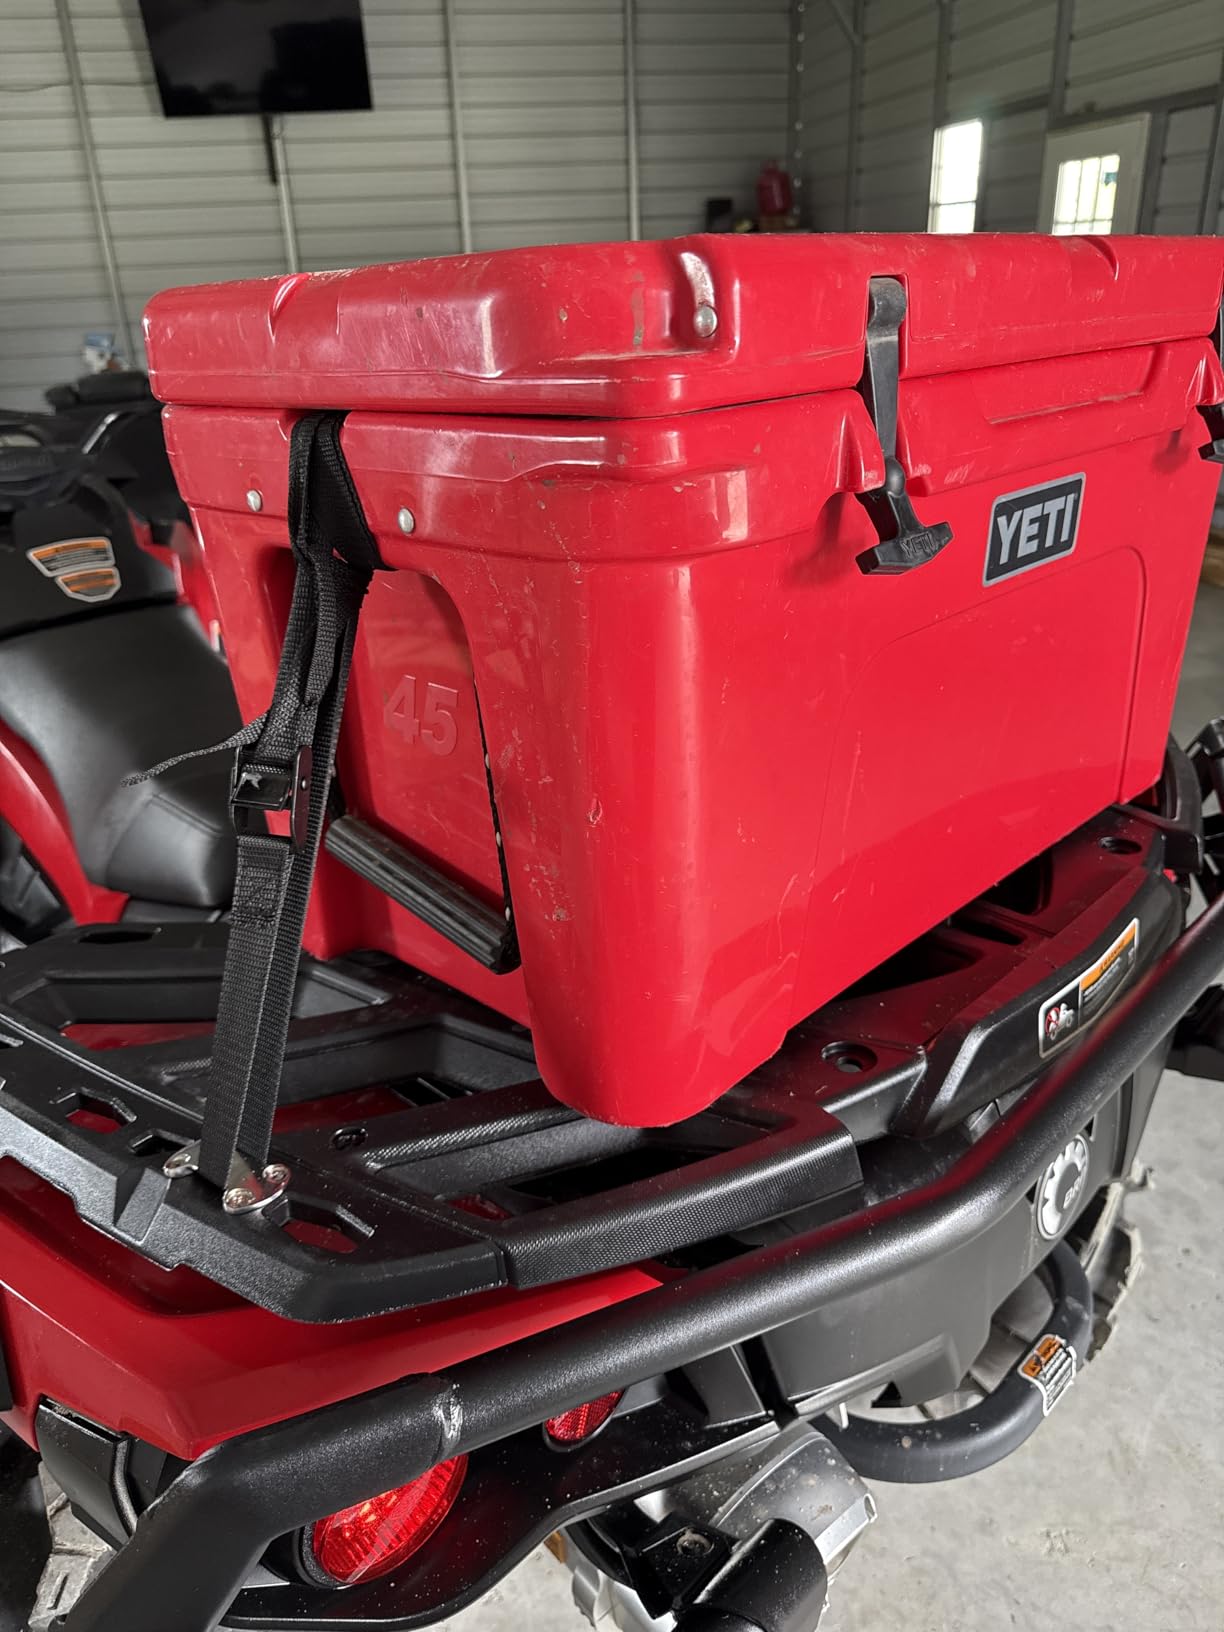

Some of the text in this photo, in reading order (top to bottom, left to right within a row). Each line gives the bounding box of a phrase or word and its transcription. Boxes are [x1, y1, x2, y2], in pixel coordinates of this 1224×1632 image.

[900, 531, 937, 560] YETI
[997, 493, 1075, 565] YETI
[383, 674, 459, 756] 45
